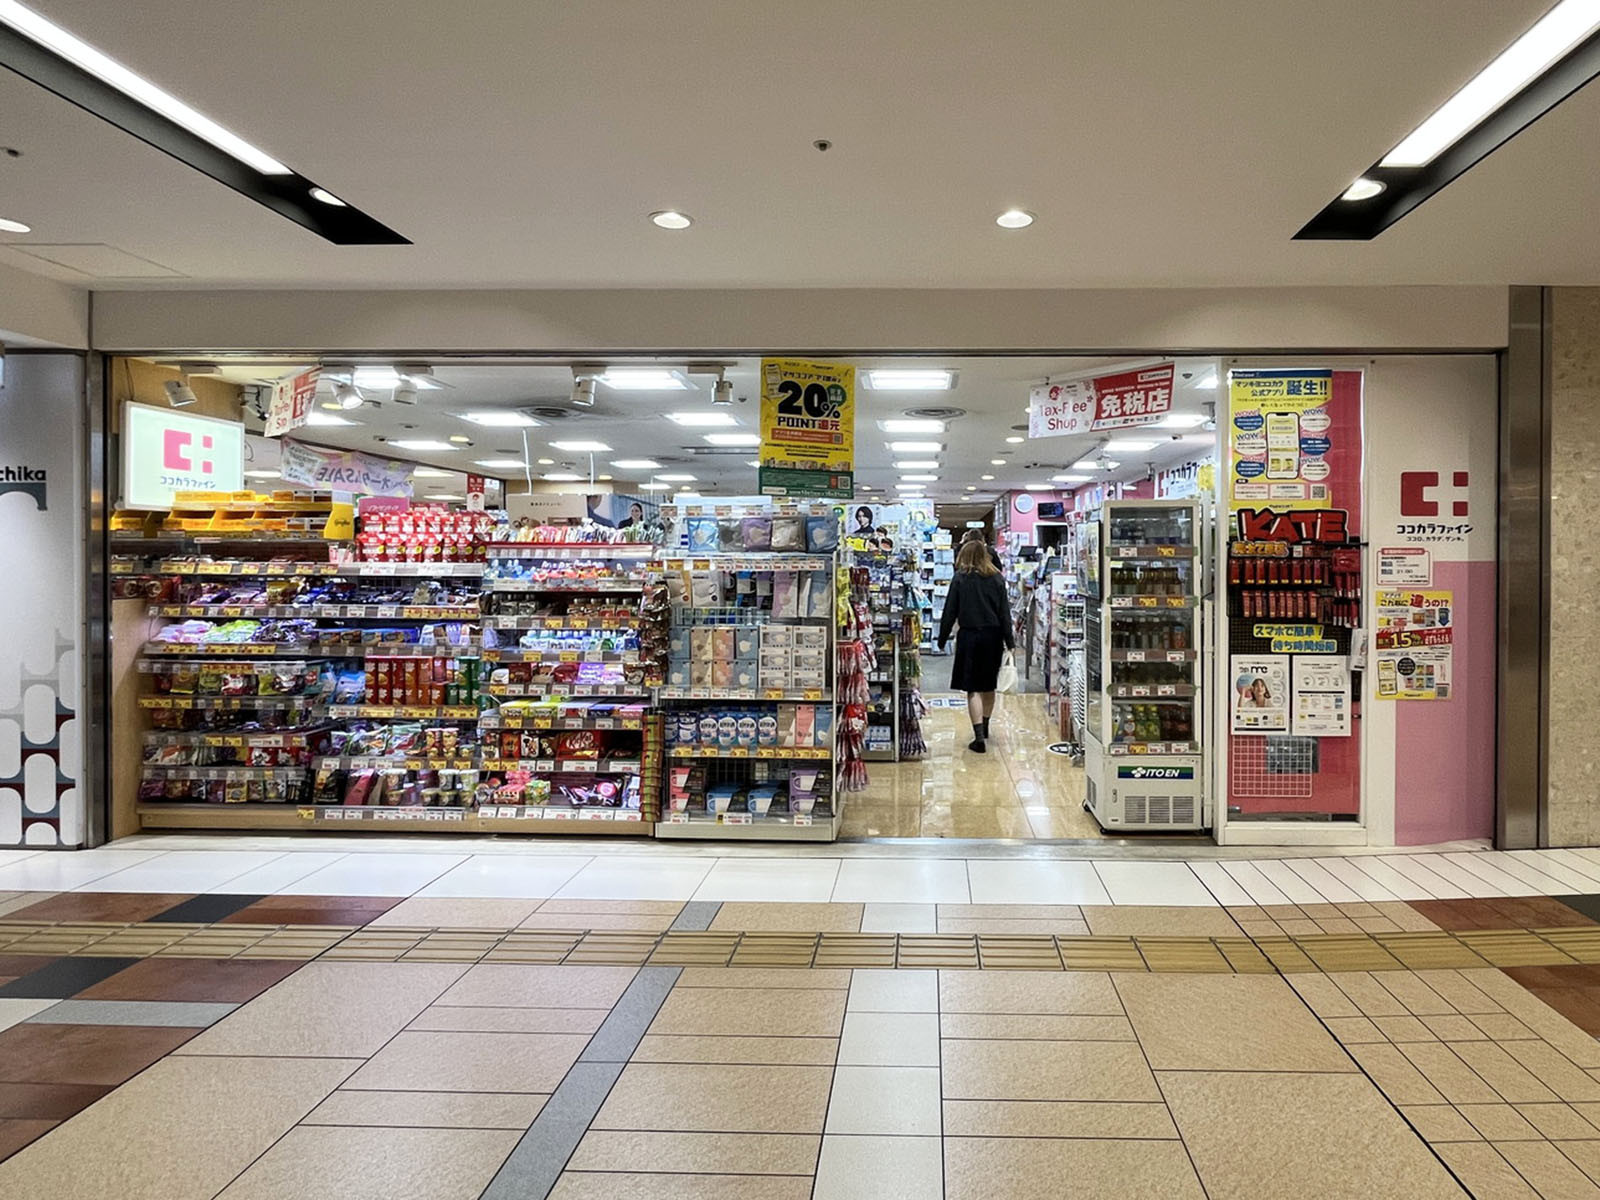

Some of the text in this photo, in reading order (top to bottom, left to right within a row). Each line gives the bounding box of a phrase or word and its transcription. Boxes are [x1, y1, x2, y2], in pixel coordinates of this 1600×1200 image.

[778, 380, 841, 419] 20%
[1251, 389, 1284, 397] 公式アプリ
[1100, 388, 1171, 418] 免税店
[1047, 417, 1078, 431] Shop
[160, 476, 216, 489] ココカラファイン
[1241, 510, 1346, 543] KATE
[1396, 523, 1474, 535] ココカラファイン
